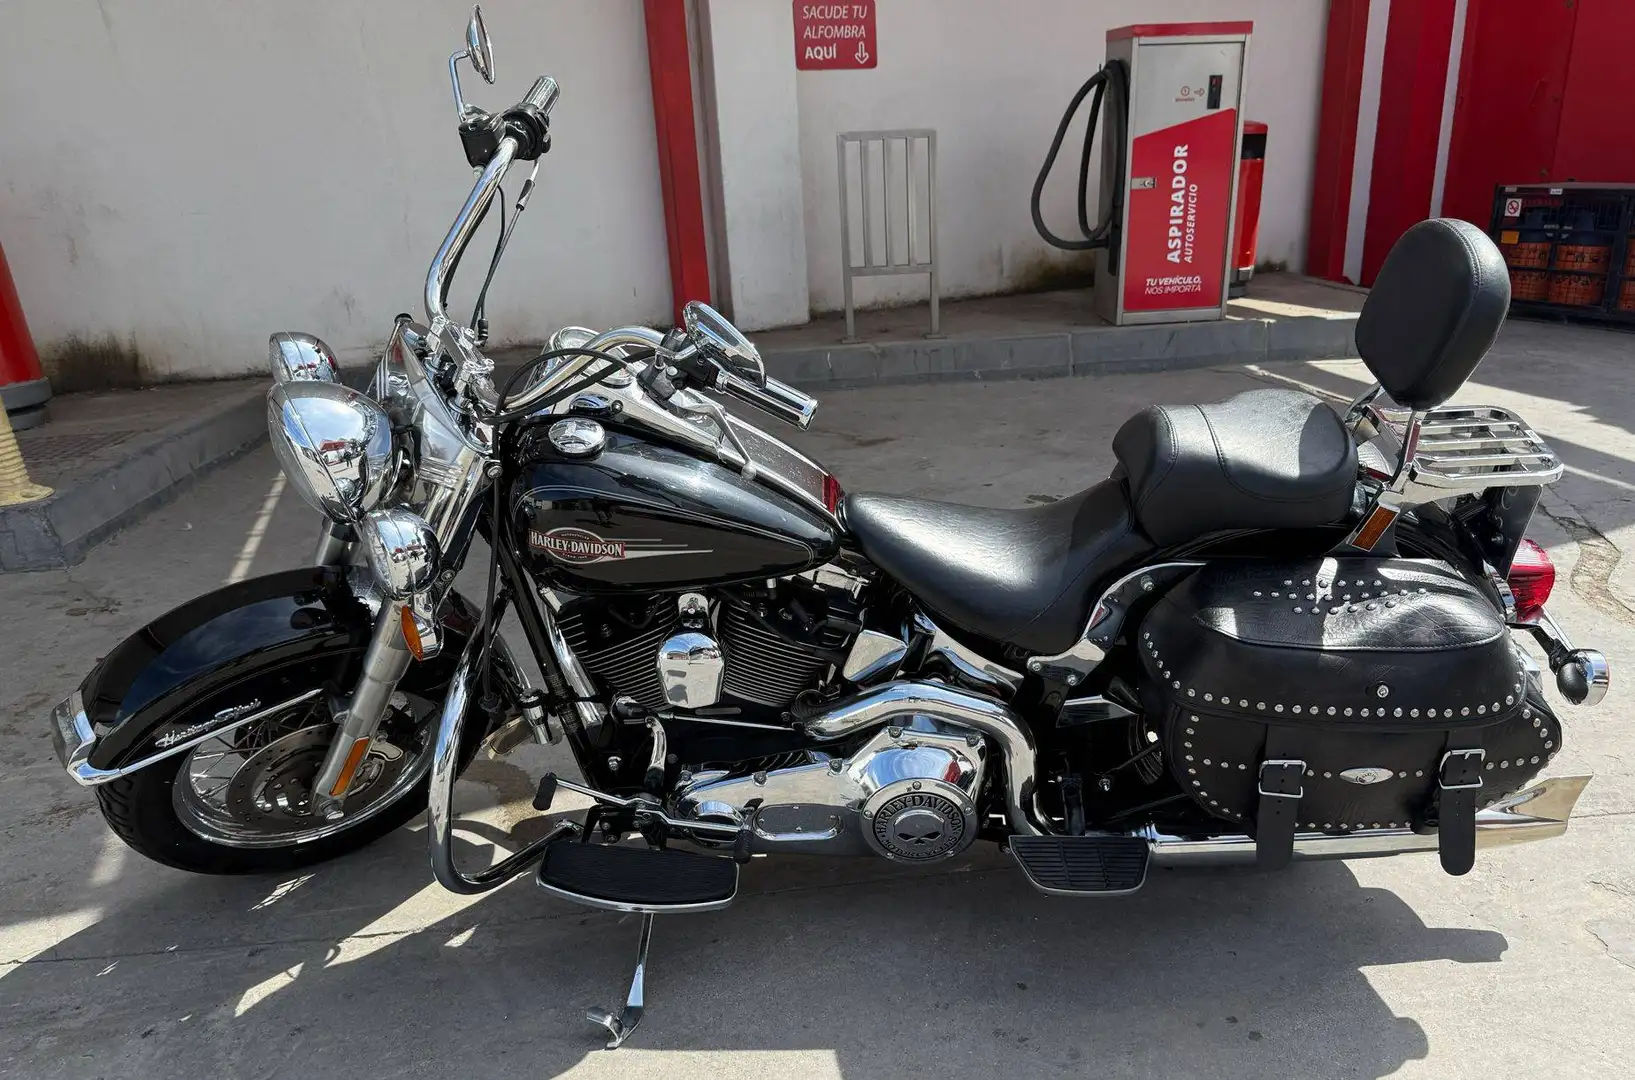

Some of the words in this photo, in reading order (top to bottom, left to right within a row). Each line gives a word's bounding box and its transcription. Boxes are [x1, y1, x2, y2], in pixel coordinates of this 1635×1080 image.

[802, 5, 849, 19] SACUDE
[852, 5, 868, 19] TU
[803, 25, 866, 39] ALFOMBRA
[804, 43, 837, 60] AQUÍ
[1167, 144, 1188, 263] ASPIRADOR
[1184, 183, 1198, 263] AUTOSERVICIO
[1145, 277, 1158, 286] TU
[1144, 286, 1163, 295] NOS
[1163, 284, 1201, 294] IMPORTA
